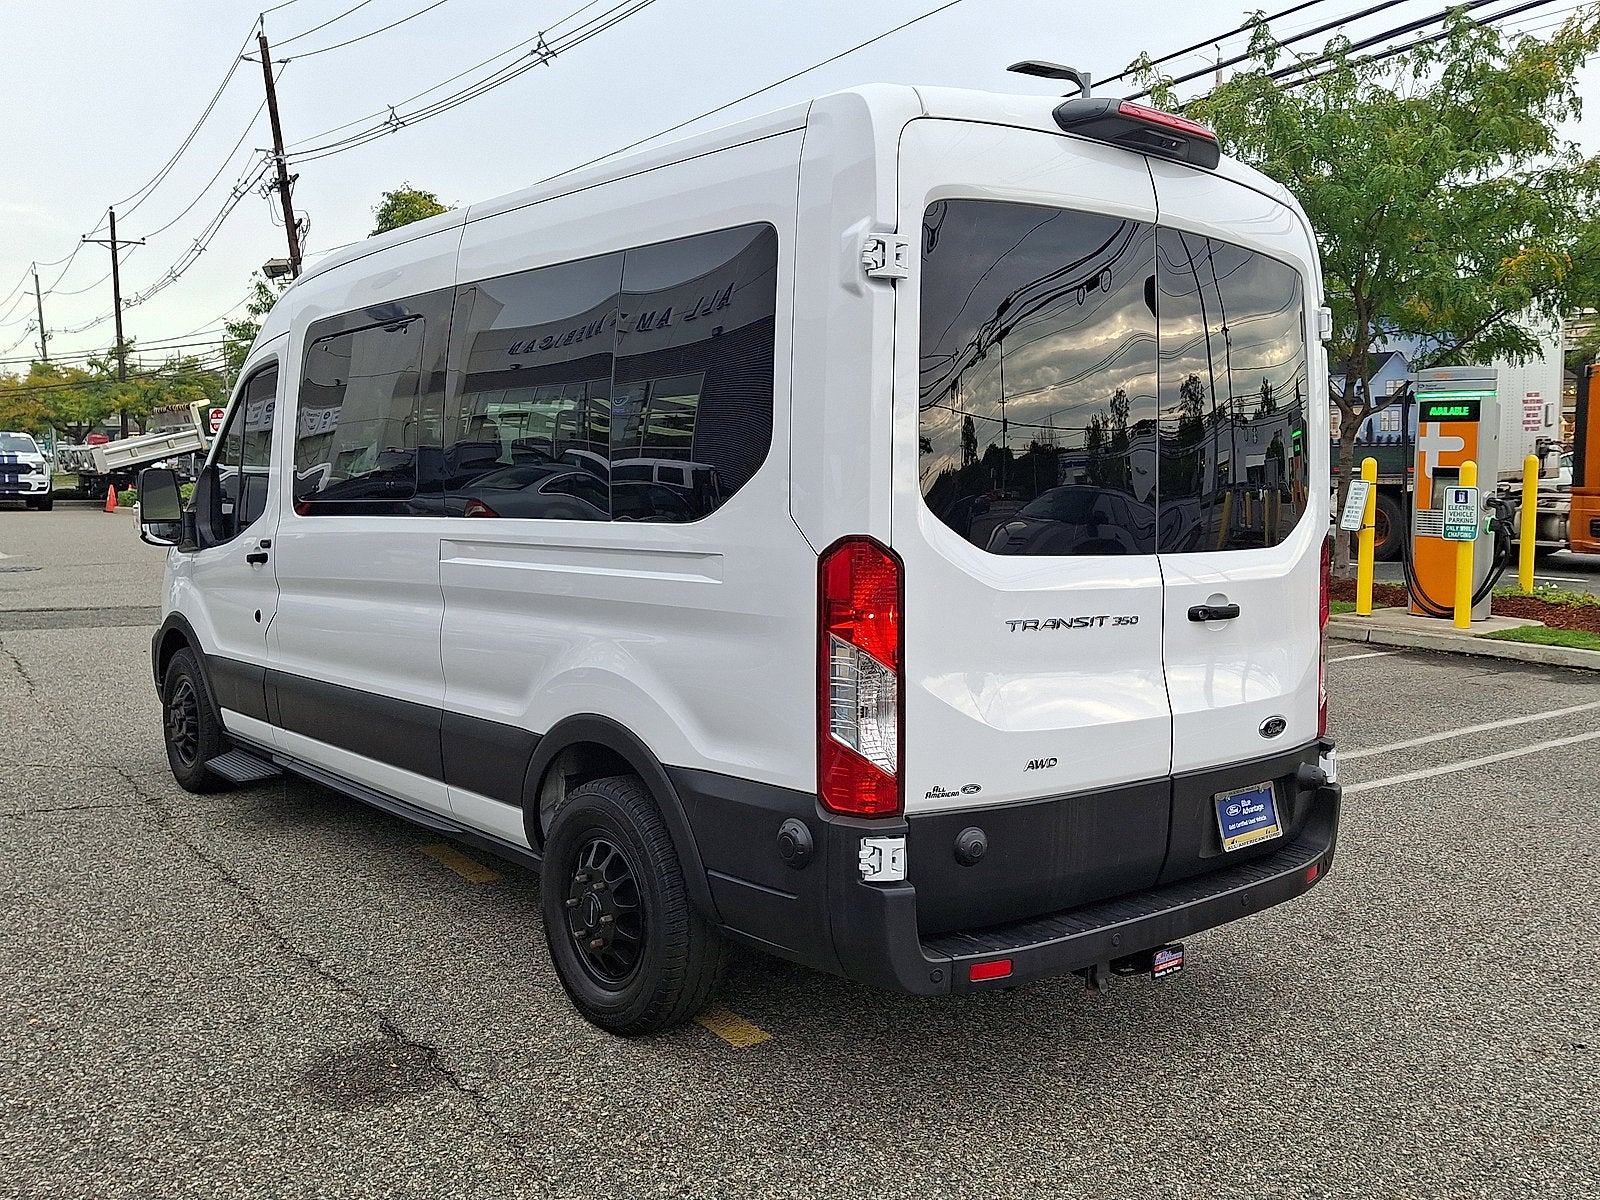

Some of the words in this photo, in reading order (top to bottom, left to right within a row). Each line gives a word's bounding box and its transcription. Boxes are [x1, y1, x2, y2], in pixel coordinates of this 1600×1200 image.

[1429, 406, 1470, 416] AVAILABLE
[1006, 615, 1110, 633] TRANSIT
[1111, 615, 1139, 626] 350
[1023, 758, 1057, 771] AWD
[1242, 804, 1264, 815] Advantage
[1238, 837, 1265, 847] AMERICAN
